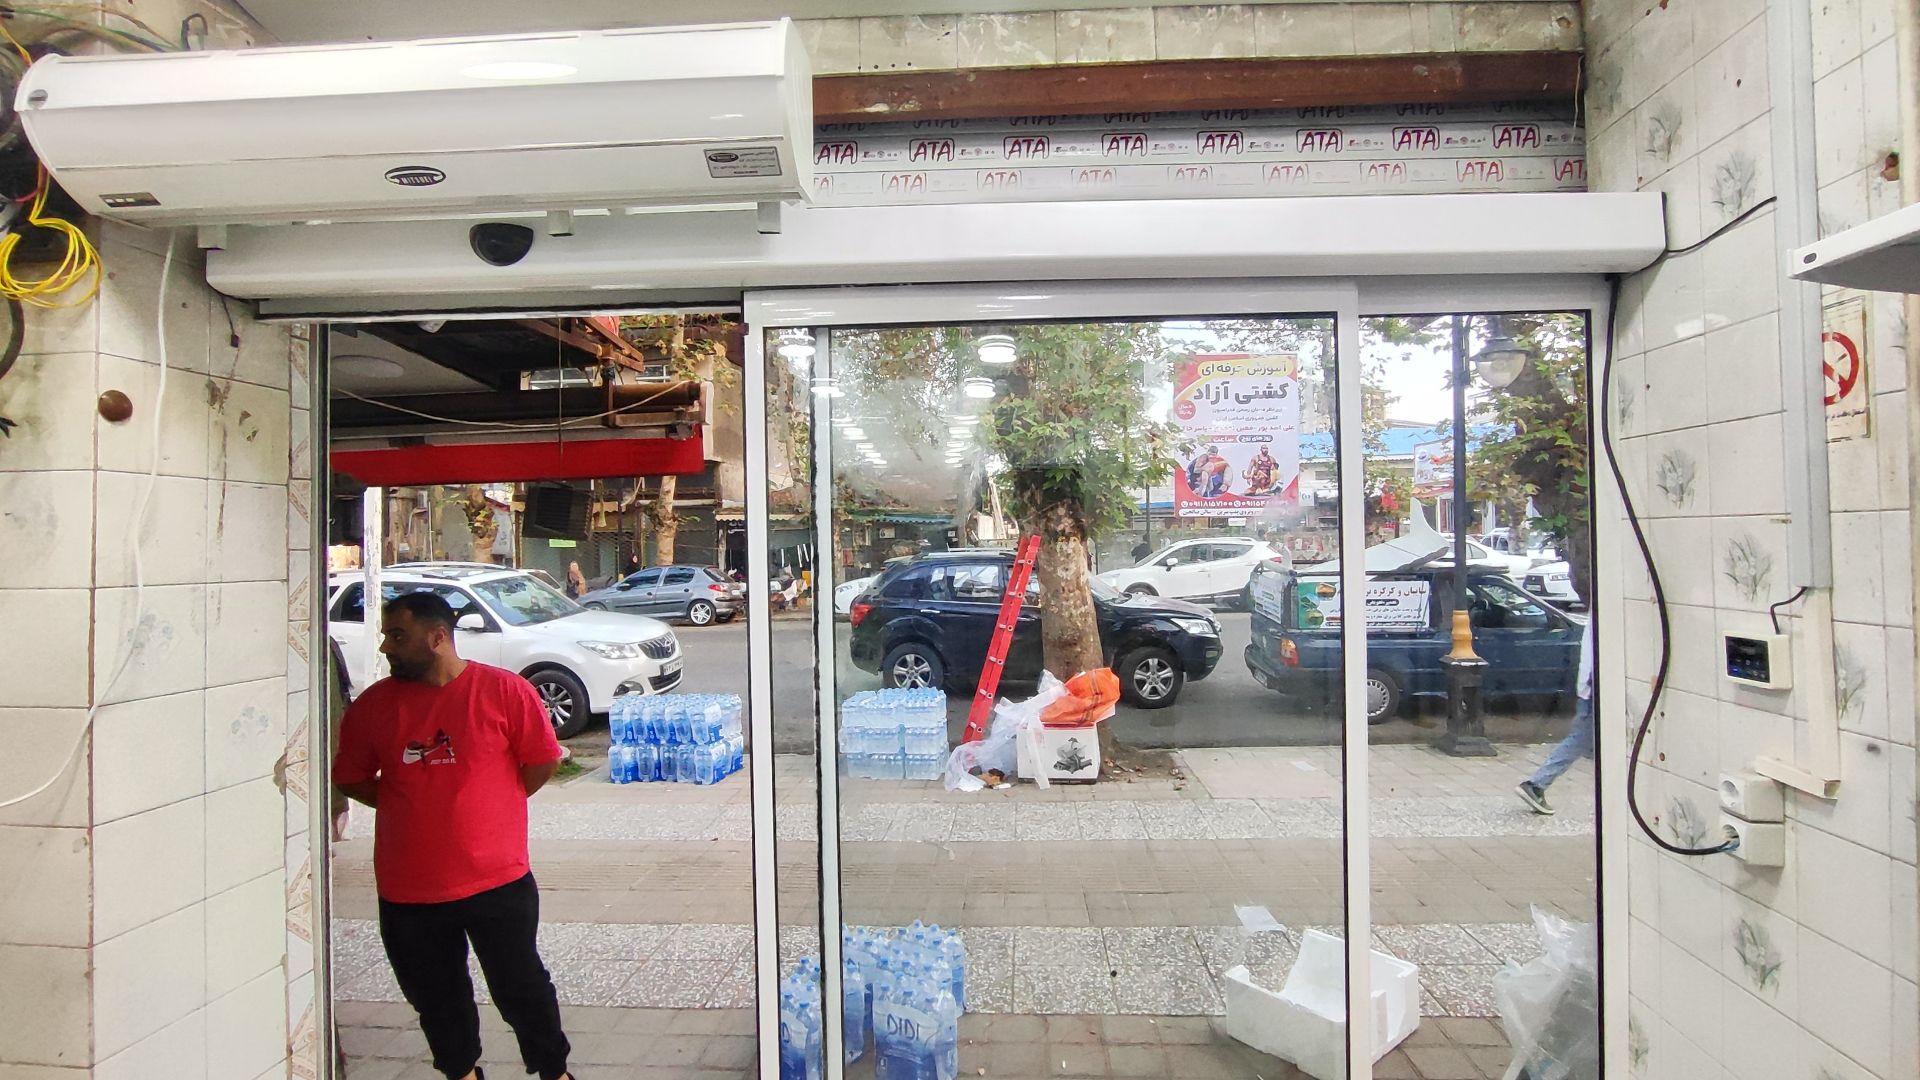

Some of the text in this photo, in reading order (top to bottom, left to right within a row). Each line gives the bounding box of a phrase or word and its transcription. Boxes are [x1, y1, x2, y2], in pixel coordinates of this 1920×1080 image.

[1106, 136, 1145, 157] ATA
[1202, 133, 1241, 153] ATA
[1301, 131, 1340, 152] ATA
[1398, 128, 1437, 150] ATA
[1498, 127, 1537, 149] ATA
[817, 144, 855, 164] ATA
[914, 142, 952, 162] ATA
[1008, 139, 1047, 159] ATA
[1079, 169, 1115, 190] ATA
[1176, 167, 1211, 188] ATA
[1270, 165, 1306, 185] ATA
[1366, 163, 1404, 185] ATA
[1462, 160, 1501, 183] ATA
[1560, 158, 1587, 181] AT
[888, 175, 924, 195] ATA
[983, 173, 1019, 194] ATA
[1193, 381, 1230, 405] آزاد
[887, 1013, 920, 1040] DIDI
